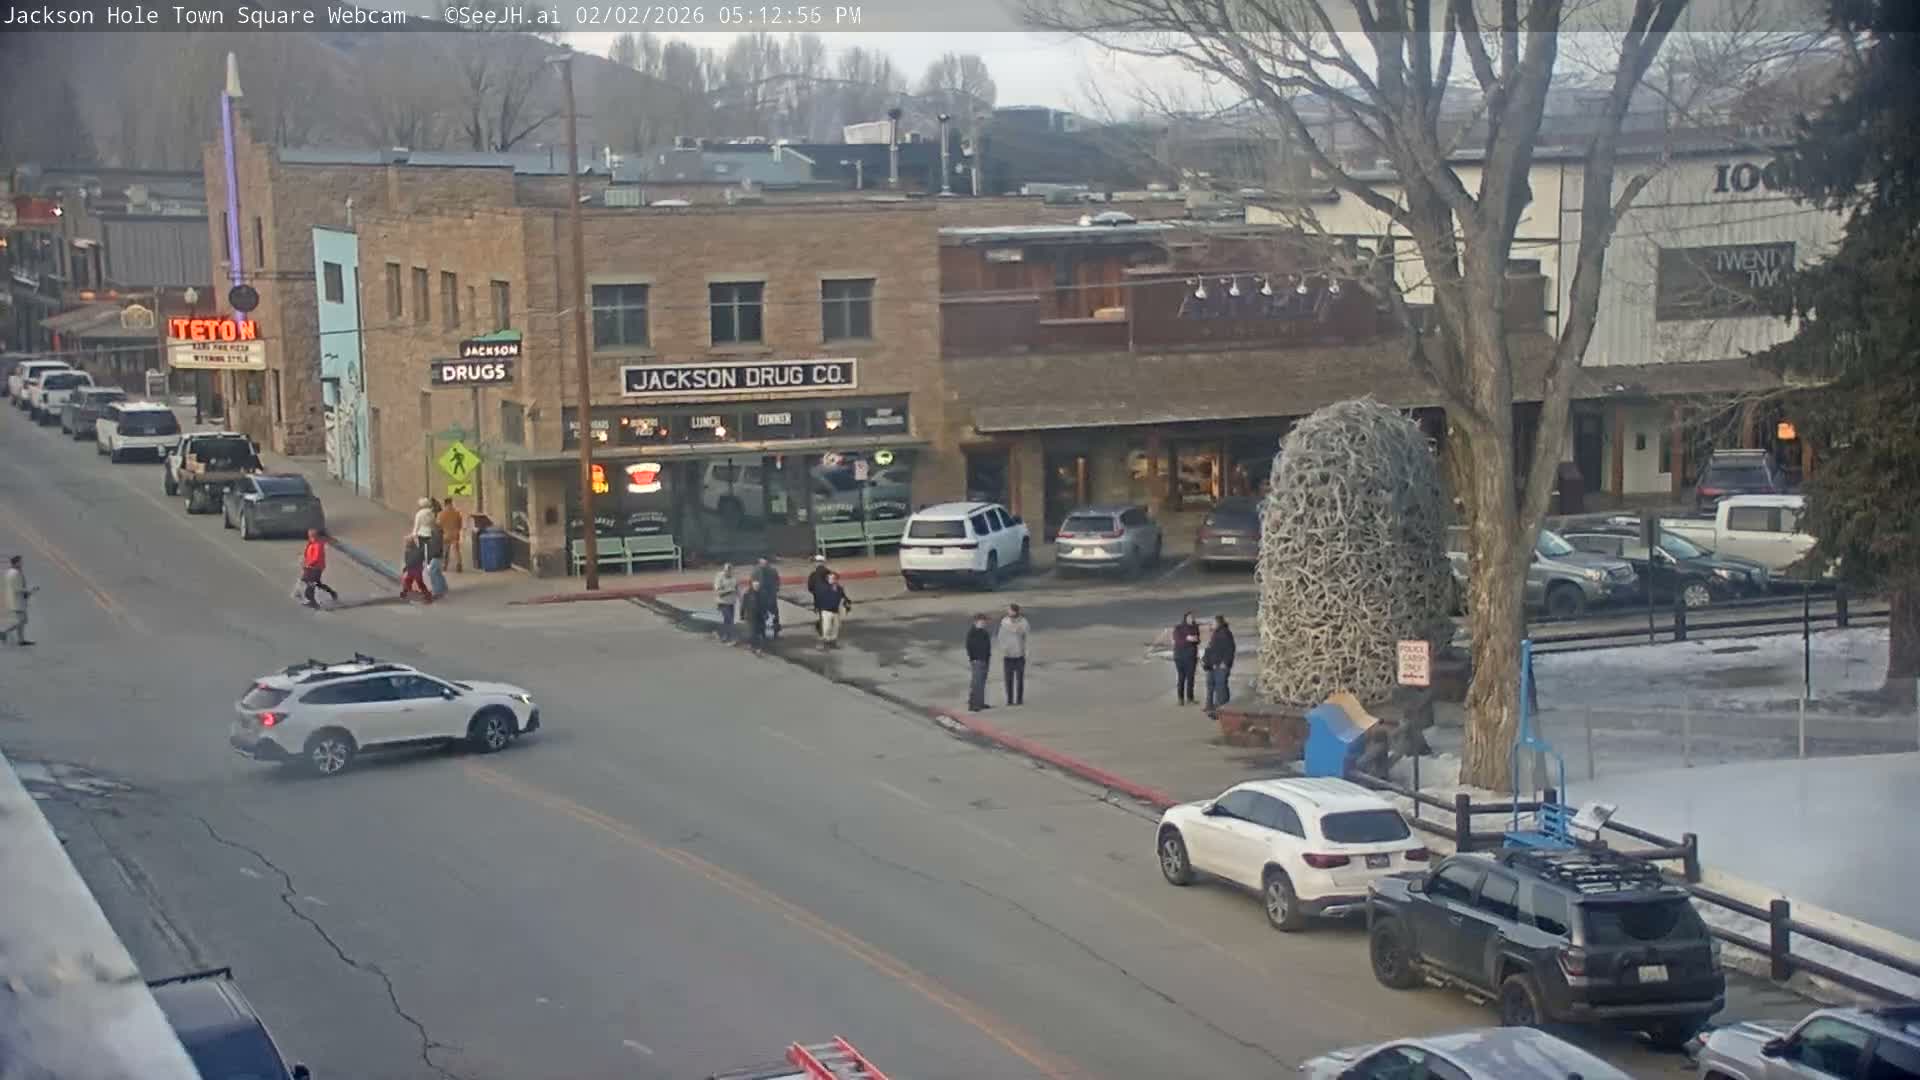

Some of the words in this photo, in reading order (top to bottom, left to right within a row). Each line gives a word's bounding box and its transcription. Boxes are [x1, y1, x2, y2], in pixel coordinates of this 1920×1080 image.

[173, 318, 256, 342] TETON
[464, 344, 518, 356] JACKSON
[442, 363, 506, 382] DRUGS
[633, 368, 736, 391] JACKSON
[745, 365, 804, 388] DRUG
[812, 364, 846, 384] CO.
